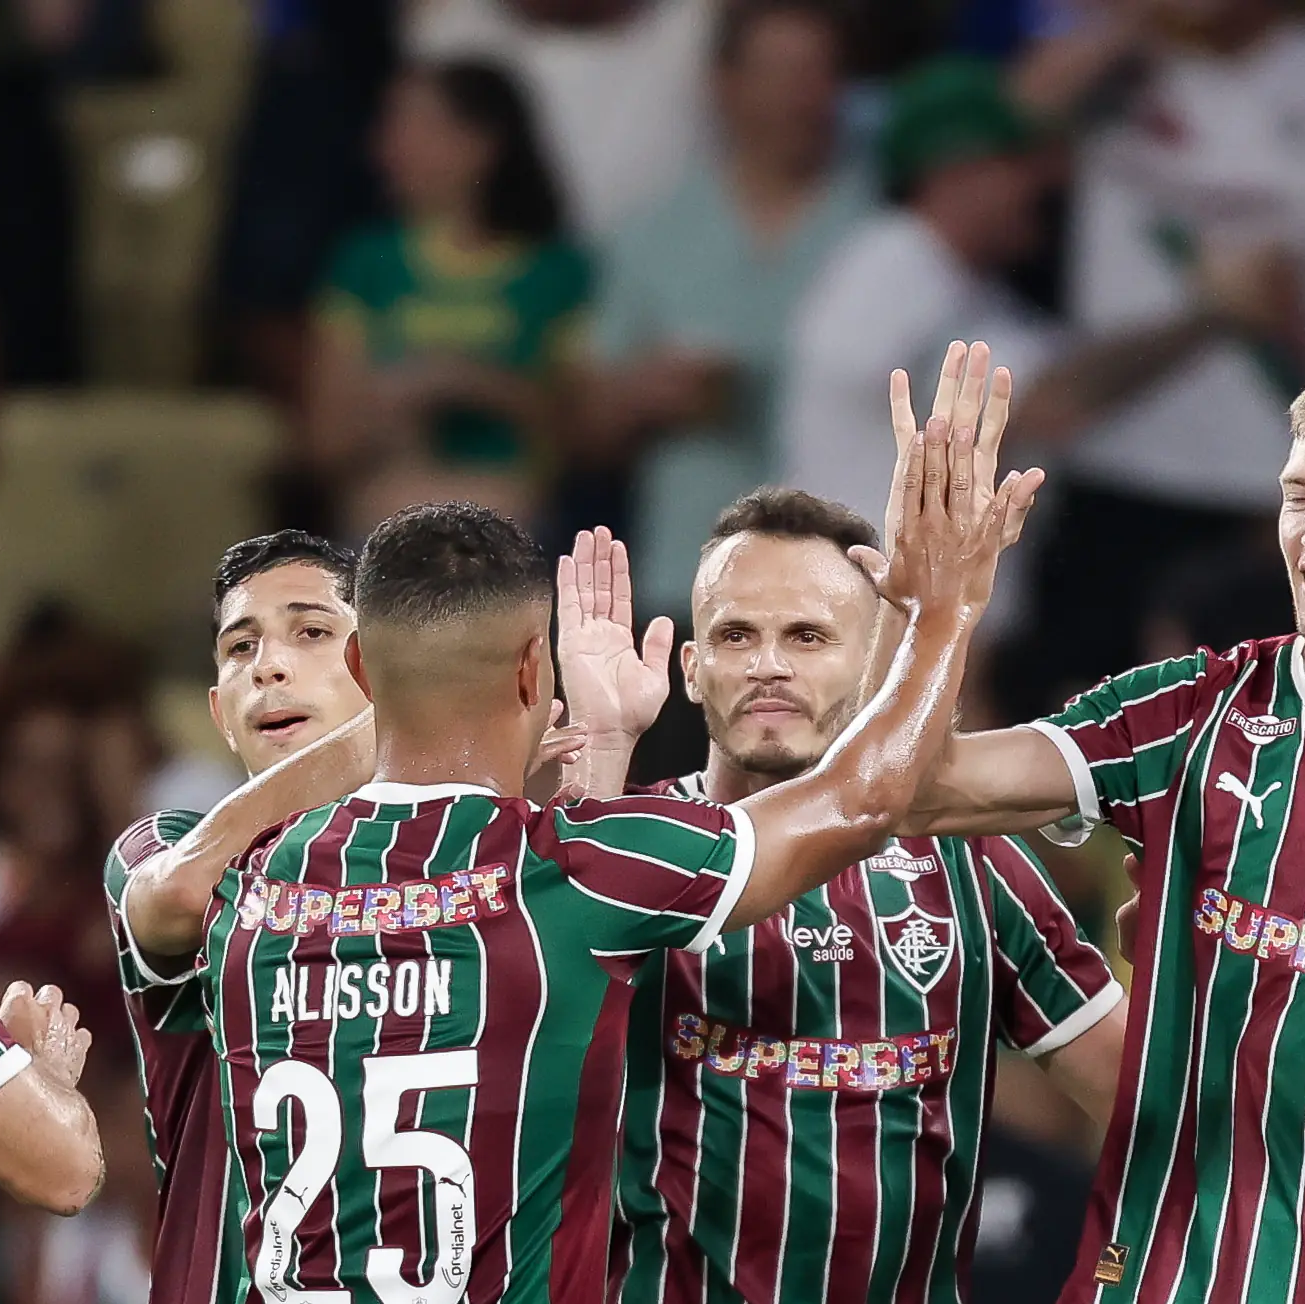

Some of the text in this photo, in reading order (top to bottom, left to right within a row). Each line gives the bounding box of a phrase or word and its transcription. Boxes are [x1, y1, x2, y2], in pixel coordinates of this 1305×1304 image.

[1229, 711, 1293, 735] FRESCATTO
[871, 855, 933, 872] FRESCATTO
[238, 866, 509, 934] SUPERBET
[271, 959, 453, 1022] ALISSON
[673, 1013, 956, 1090] SUPERBET
